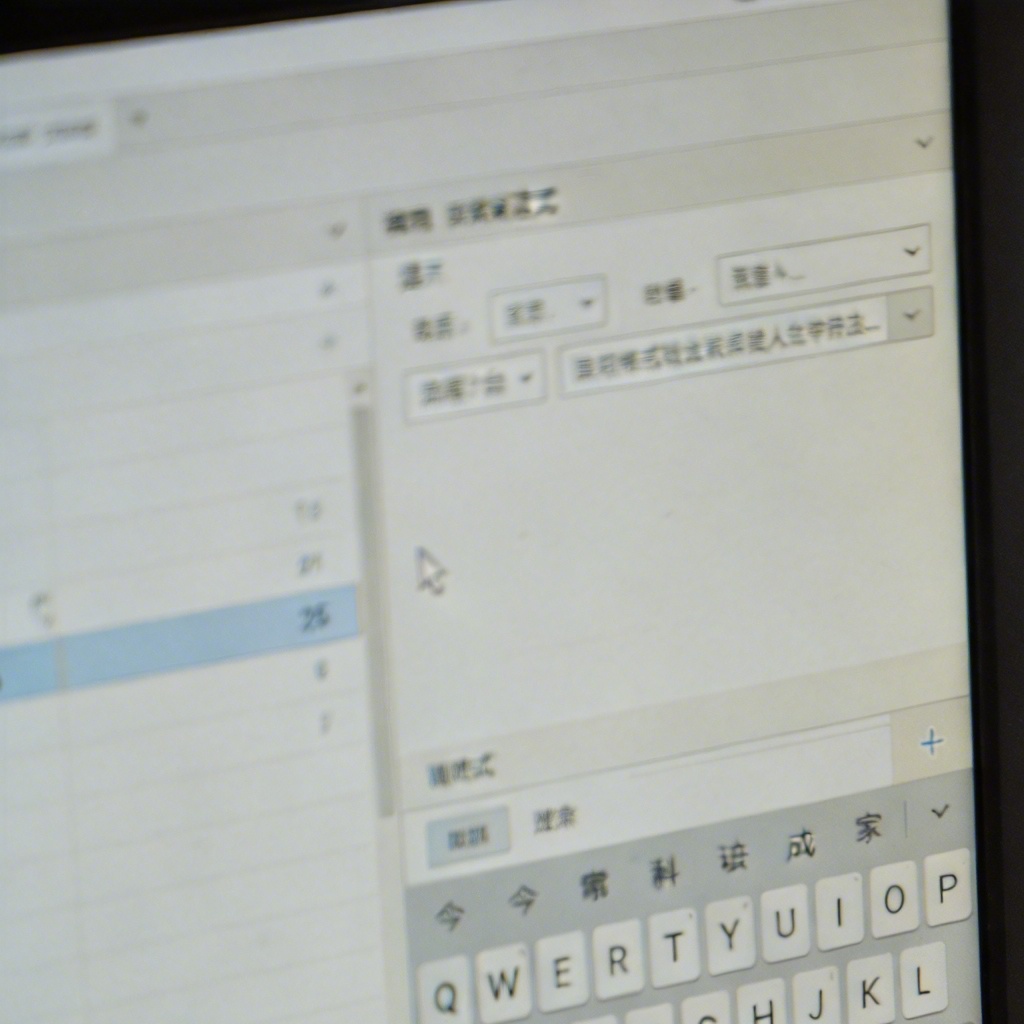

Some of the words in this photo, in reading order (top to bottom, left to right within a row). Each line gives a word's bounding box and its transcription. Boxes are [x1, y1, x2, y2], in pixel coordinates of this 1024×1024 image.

[855, 812, 882, 844] 家
[434, 981, 457, 1015] Q
[487, 967, 519, 1001] W
[552, 955, 571, 989] E
[608, 944, 629, 976] R
[663, 931, 684, 963] T
[719, 919, 740, 951] Y
[775, 907, 796, 939] U
[884, 884, 906, 915] O
[939, 873, 958, 904] P
[808, 988, 823, 1021] J
[861, 976, 880, 1009] K
[916, 966, 931, 996] L
